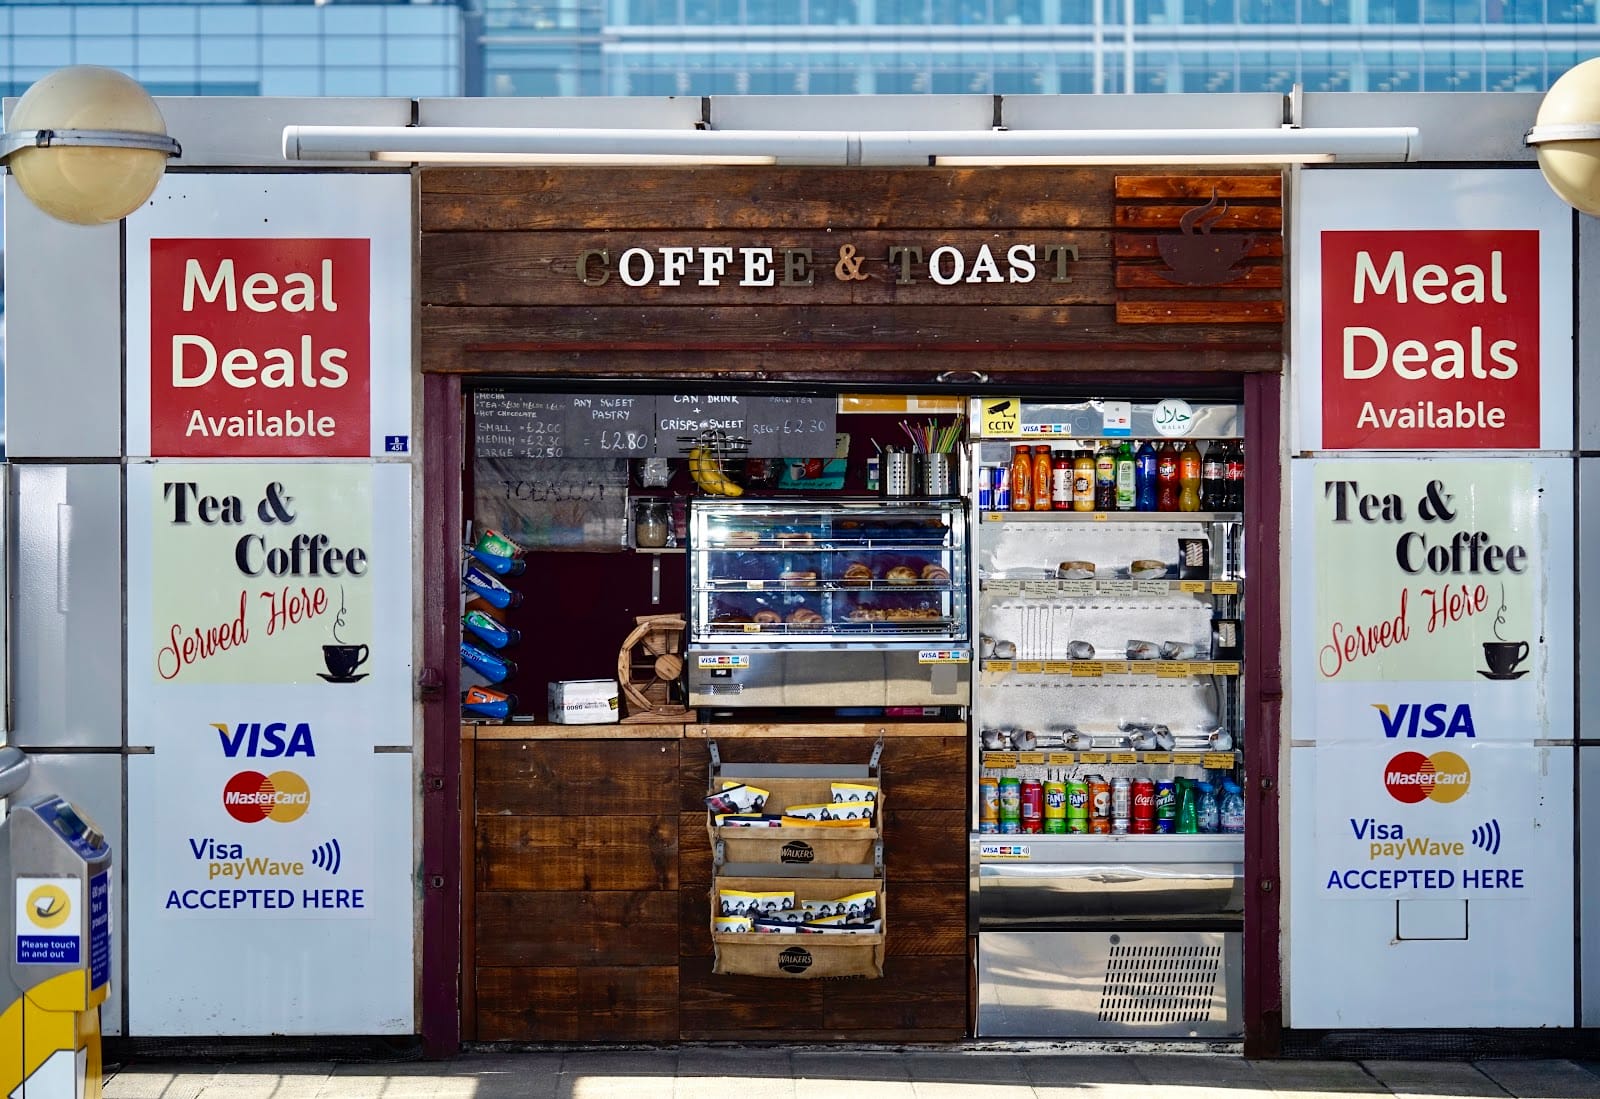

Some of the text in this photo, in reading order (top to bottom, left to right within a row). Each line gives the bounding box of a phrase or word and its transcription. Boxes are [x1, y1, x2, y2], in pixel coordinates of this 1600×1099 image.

[576, 243, 1079, 288] COFFEE & TOAST
[182, 258, 338, 312] Meal
[1353, 250, 1507, 304] Meal
[172, 335, 349, 388] Deals
[1343, 326, 1519, 380] Deals
[574, 398, 592, 408] ANY
[600, 398, 635, 408] SWEET
[185, 410, 336, 437] Available
[592, 409, 630, 420] PASTRY
[709, 418, 744, 429] SWEET
[1156, 405, 1191, 424] حلال
[1356, 401, 1506, 429] Available
[479, 423, 512, 432] SMALL
[988, 421, 1014, 431] CCTV
[600, 430, 648, 450] £2.80
[478, 448, 514, 458] LARGE
[164, 481, 296, 525] Tea &
[1325, 480, 1456, 523] Tea &
[235, 533, 368, 577] Coffee
[1396, 531, 1528, 575] Coffee
[158, 586, 329, 679] Served Here
[1319, 584, 1488, 677] Served Here
[1371, 703, 1476, 738] VISA
[209, 723, 315, 758] VISA
[1386, 771, 1470, 785] MasterCard
[225, 791, 309, 805] MasterCard
[1350, 818, 1404, 840] Visa
[189, 838, 243, 859] Visa
[781, 847, 814, 858] WALKERS
[1370, 837, 1465, 860] payWave
[209, 857, 304, 880] payWave
[1326, 869, 1525, 889] ACCEPTED HERE
[165, 889, 365, 909] ACCEPTED HERE
[21, 941, 75, 949] Please touch
[21, 950, 29, 958] in
[32, 950, 47, 958] and
[778, 954, 812, 965] WALKERS
